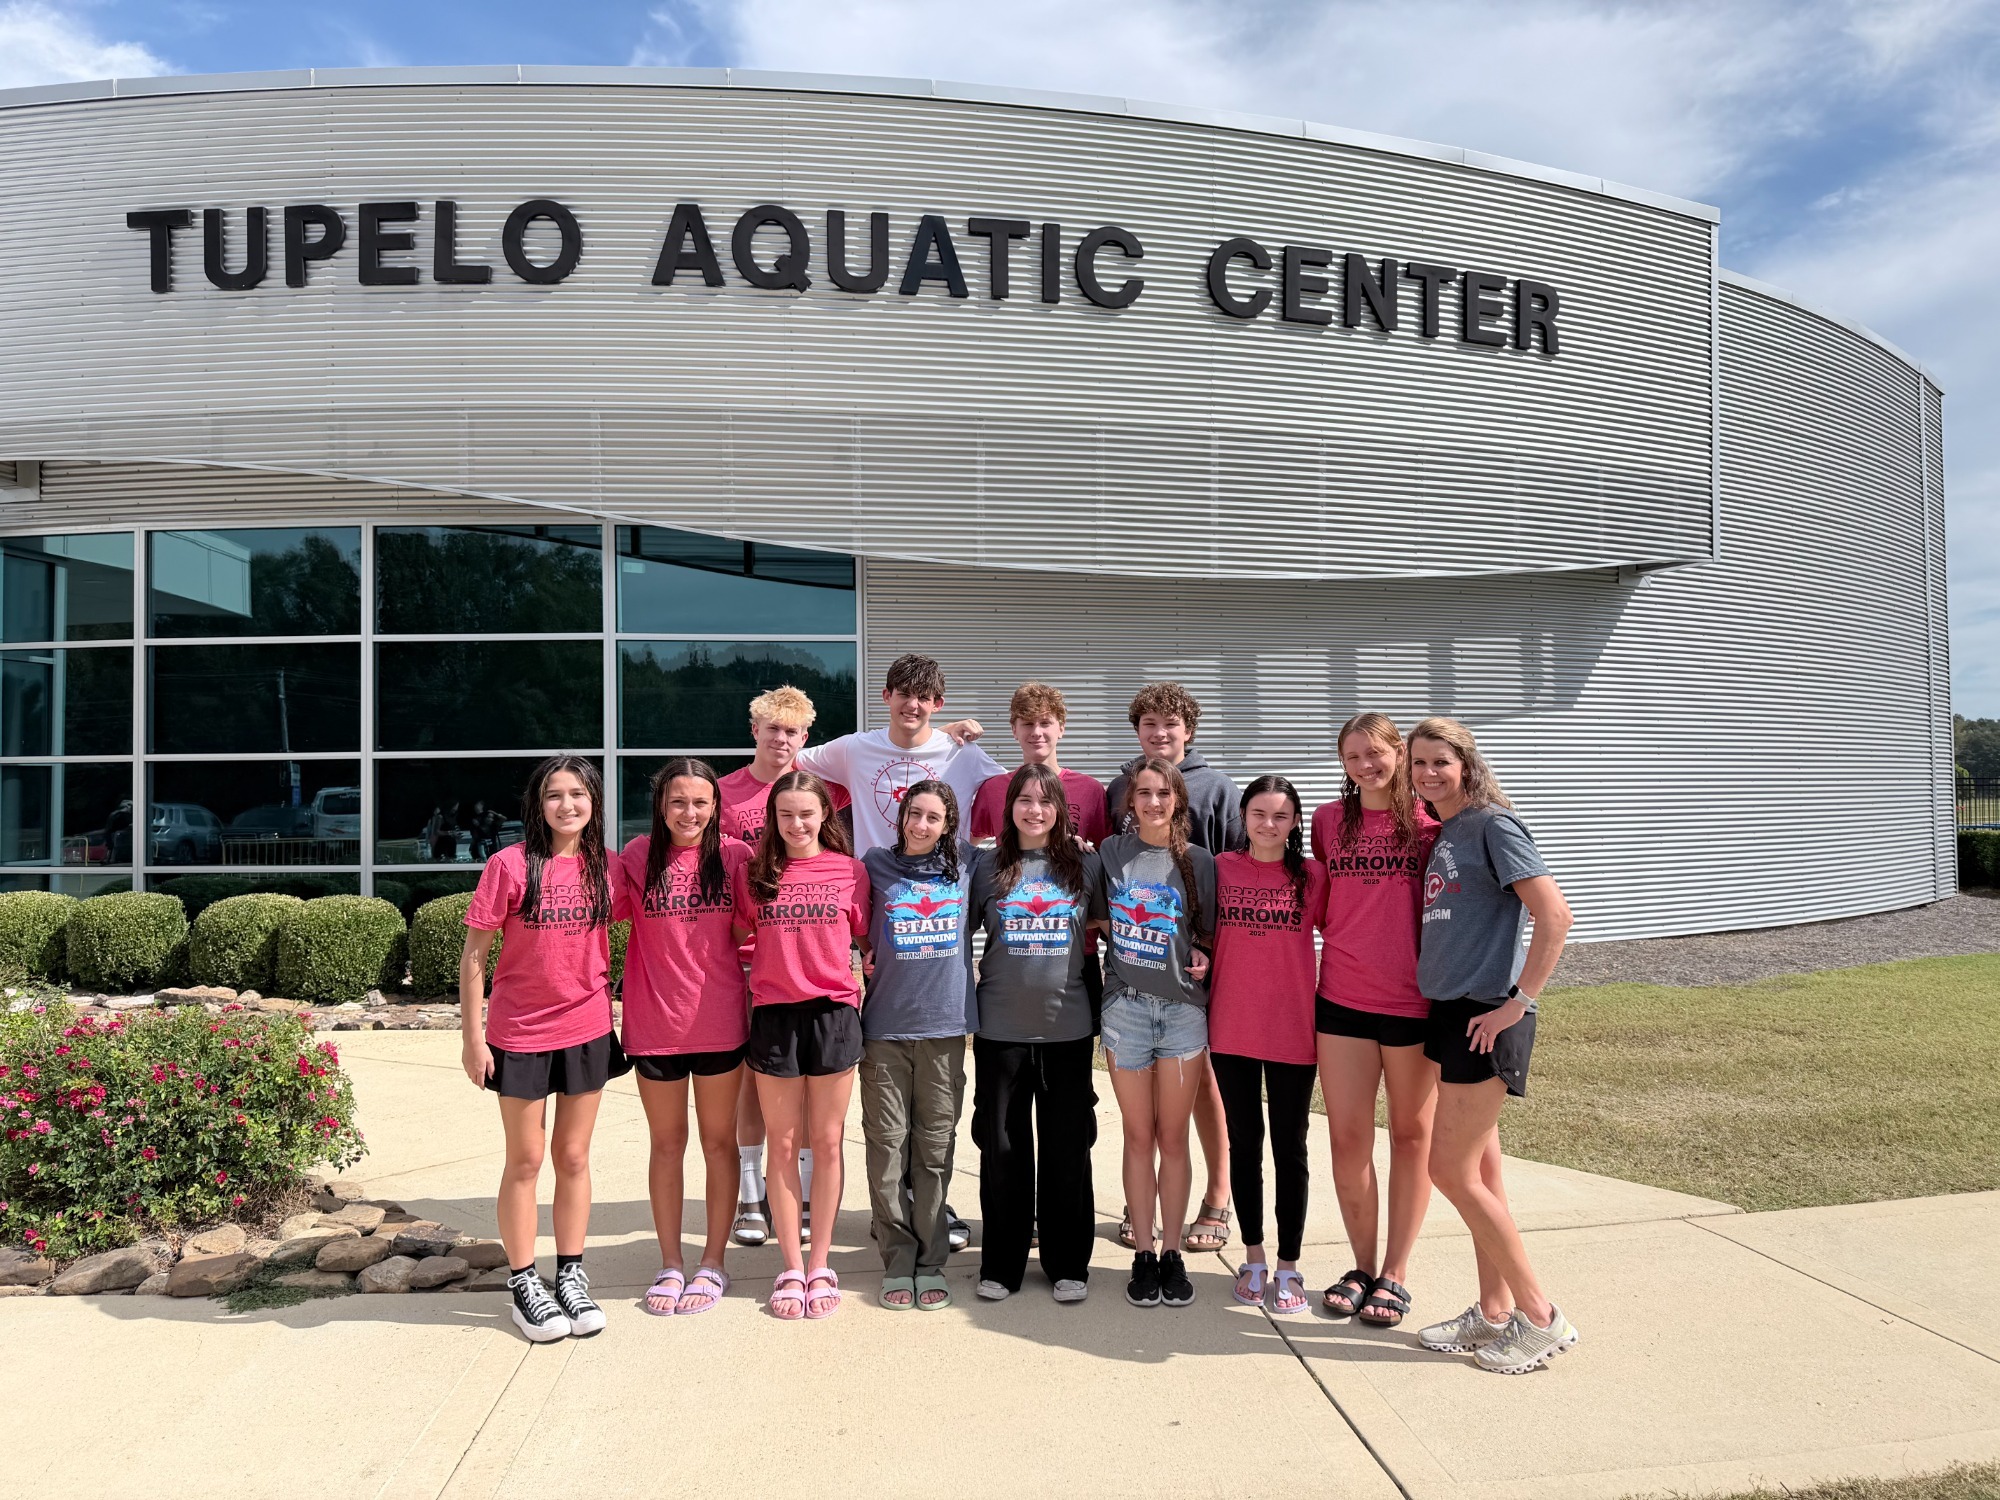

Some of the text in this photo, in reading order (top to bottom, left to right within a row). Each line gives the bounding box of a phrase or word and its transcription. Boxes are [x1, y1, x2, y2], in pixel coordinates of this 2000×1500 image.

[126, 199, 1561, 355] TUPELO AQUATIC CENTER
[924, 763, 940, 780] SCHO
[1329, 856, 1419, 872] ARROWS
[1399, 871, 1419, 879] TEAM
[644, 893, 733, 913] ARROWS
[1220, 907, 1302, 926] ARROWS
[1431, 908, 1451, 920] EAM
[554, 922, 577, 930] STATE
[893, 917, 959, 934] STATE
[1005, 917, 1069, 930] STATE
[1238, 921, 1260, 929] STATE
[1262, 923, 1282, 931] SWIM
[564, 929, 582, 937] 2025
[896, 932, 957, 945] SWIMMING
[1007, 932, 1067, 941] SWIMMING
[1112, 920, 1169, 945] STATE
